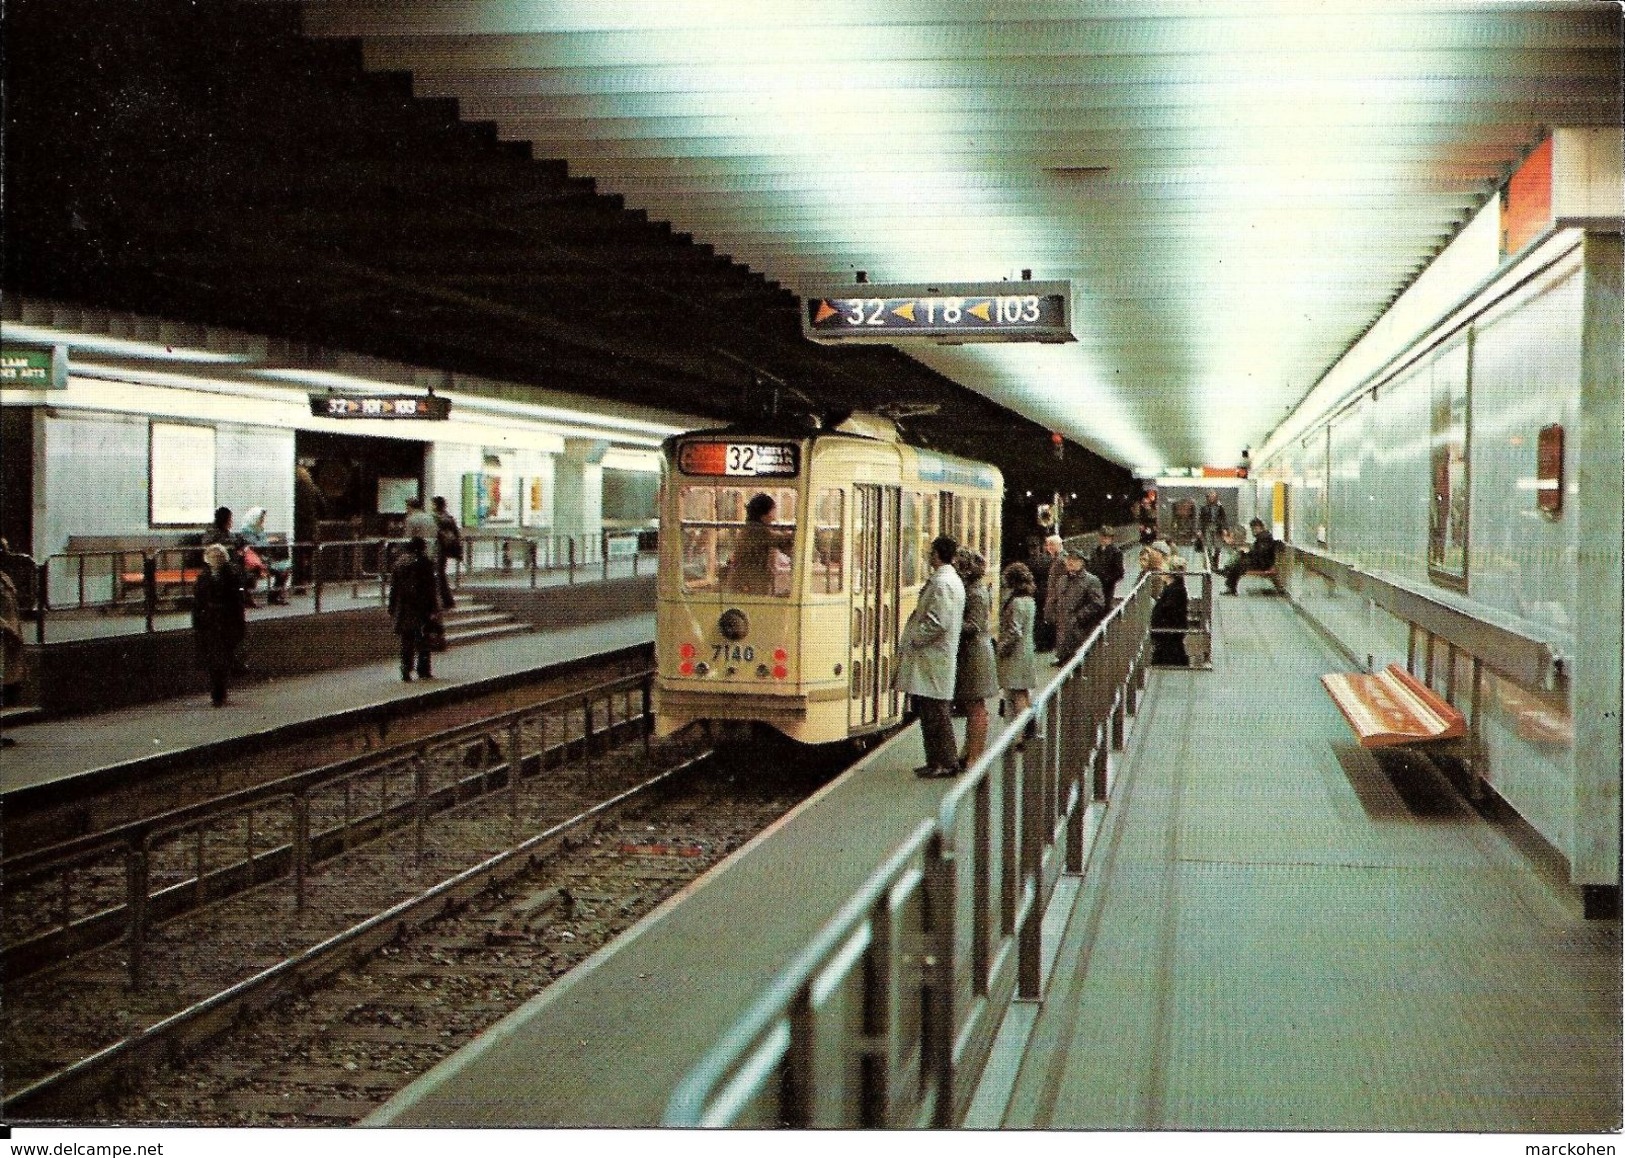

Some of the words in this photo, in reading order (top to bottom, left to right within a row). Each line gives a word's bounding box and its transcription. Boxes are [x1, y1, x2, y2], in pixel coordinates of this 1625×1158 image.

[847, 298, 886, 325] 32
[919, 297, 962, 323] 18
[995, 295, 1040, 323] 103
[328, 398, 346, 413] 32
[729, 446, 754, 471] 32
[711, 644, 754, 662] 7140
